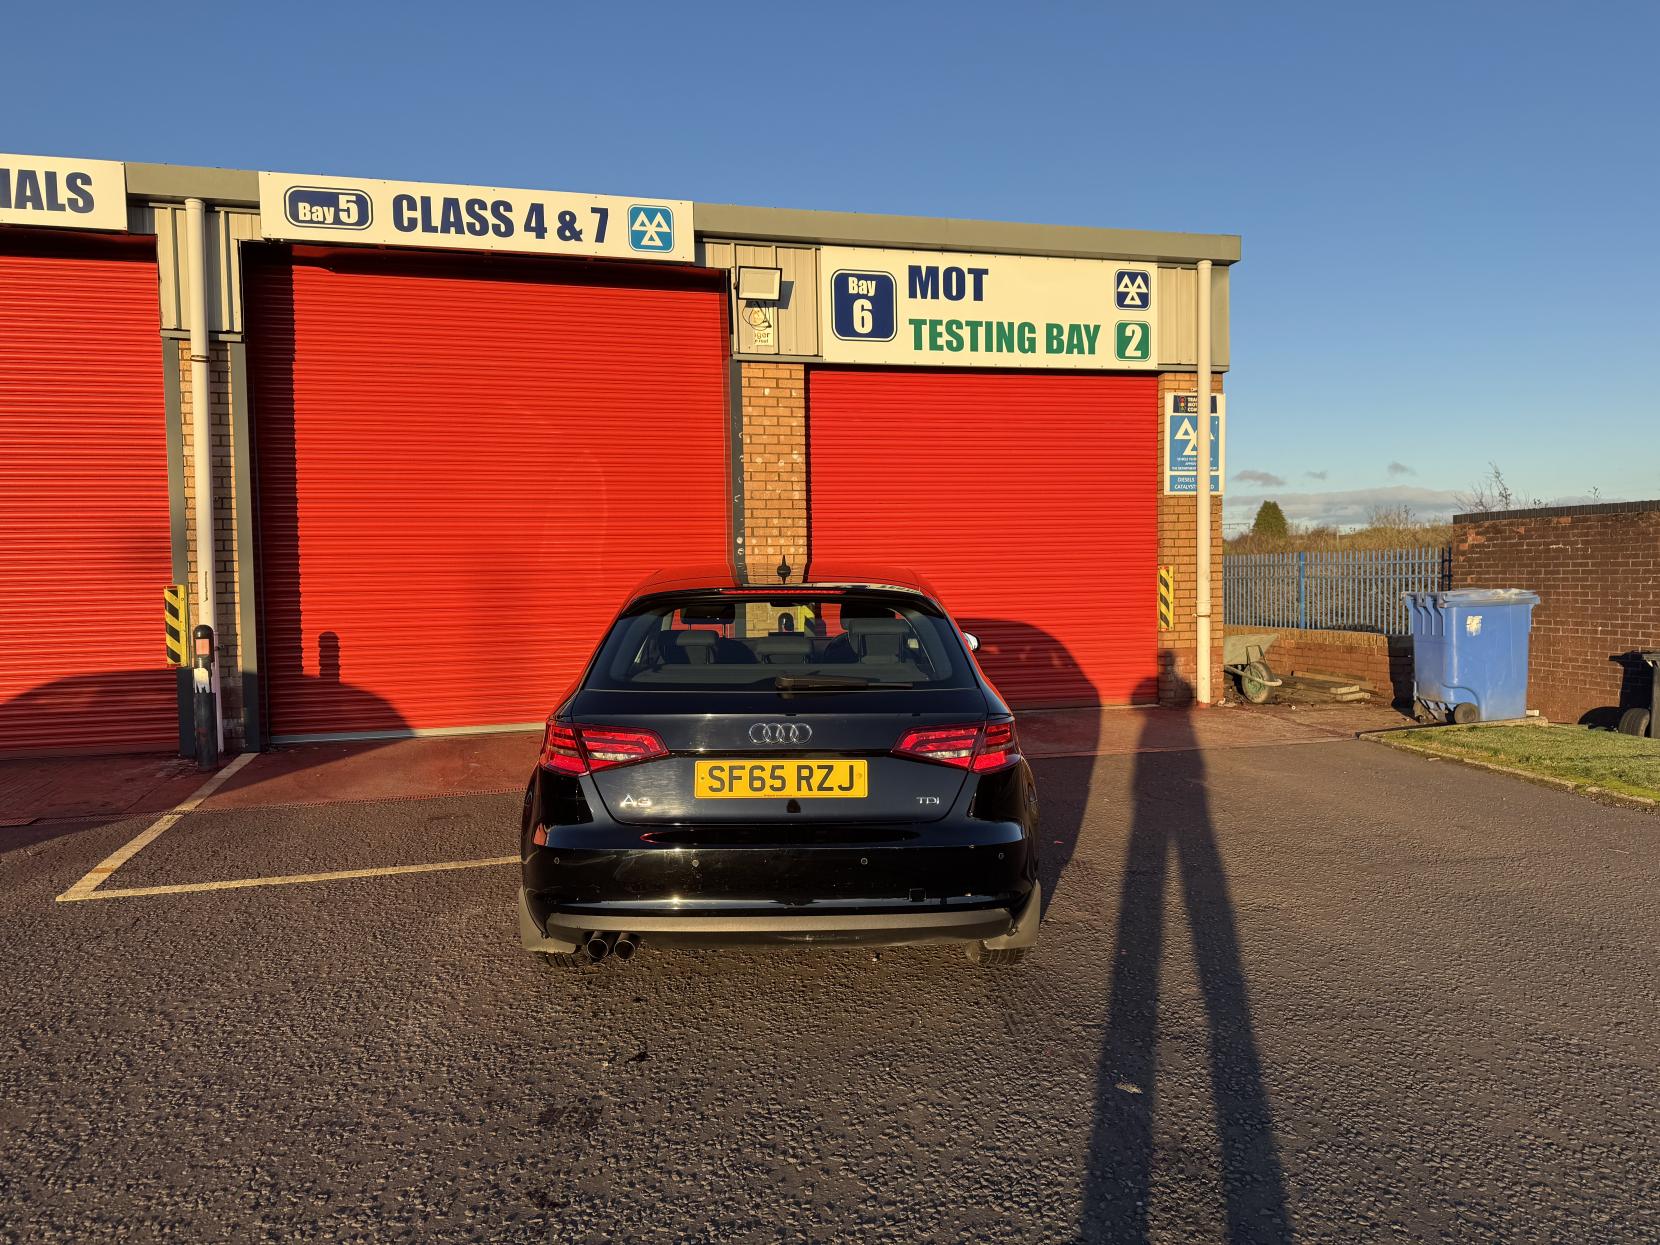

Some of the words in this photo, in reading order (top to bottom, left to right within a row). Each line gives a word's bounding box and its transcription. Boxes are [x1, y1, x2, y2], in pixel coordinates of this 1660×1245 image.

[297, 202, 335, 224] Bay
[338, 194, 360, 224] 5
[392, 193, 515, 238] CLASS
[523, 202, 548, 240] 4
[556, 210, 584, 242] &
[590, 206, 609, 243] 7
[848, 276, 876, 297] Bay
[908, 264, 989, 302] MOT
[852, 298, 873, 334] 6
[908, 318, 1037, 354] TESTING
[1045, 322, 1101, 355] BAY
[1124, 323, 1142, 357] 2
[708, 765, 787, 793] SF65
[796, 764, 855, 792] RZJ
[916, 796, 940, 804] TDI
